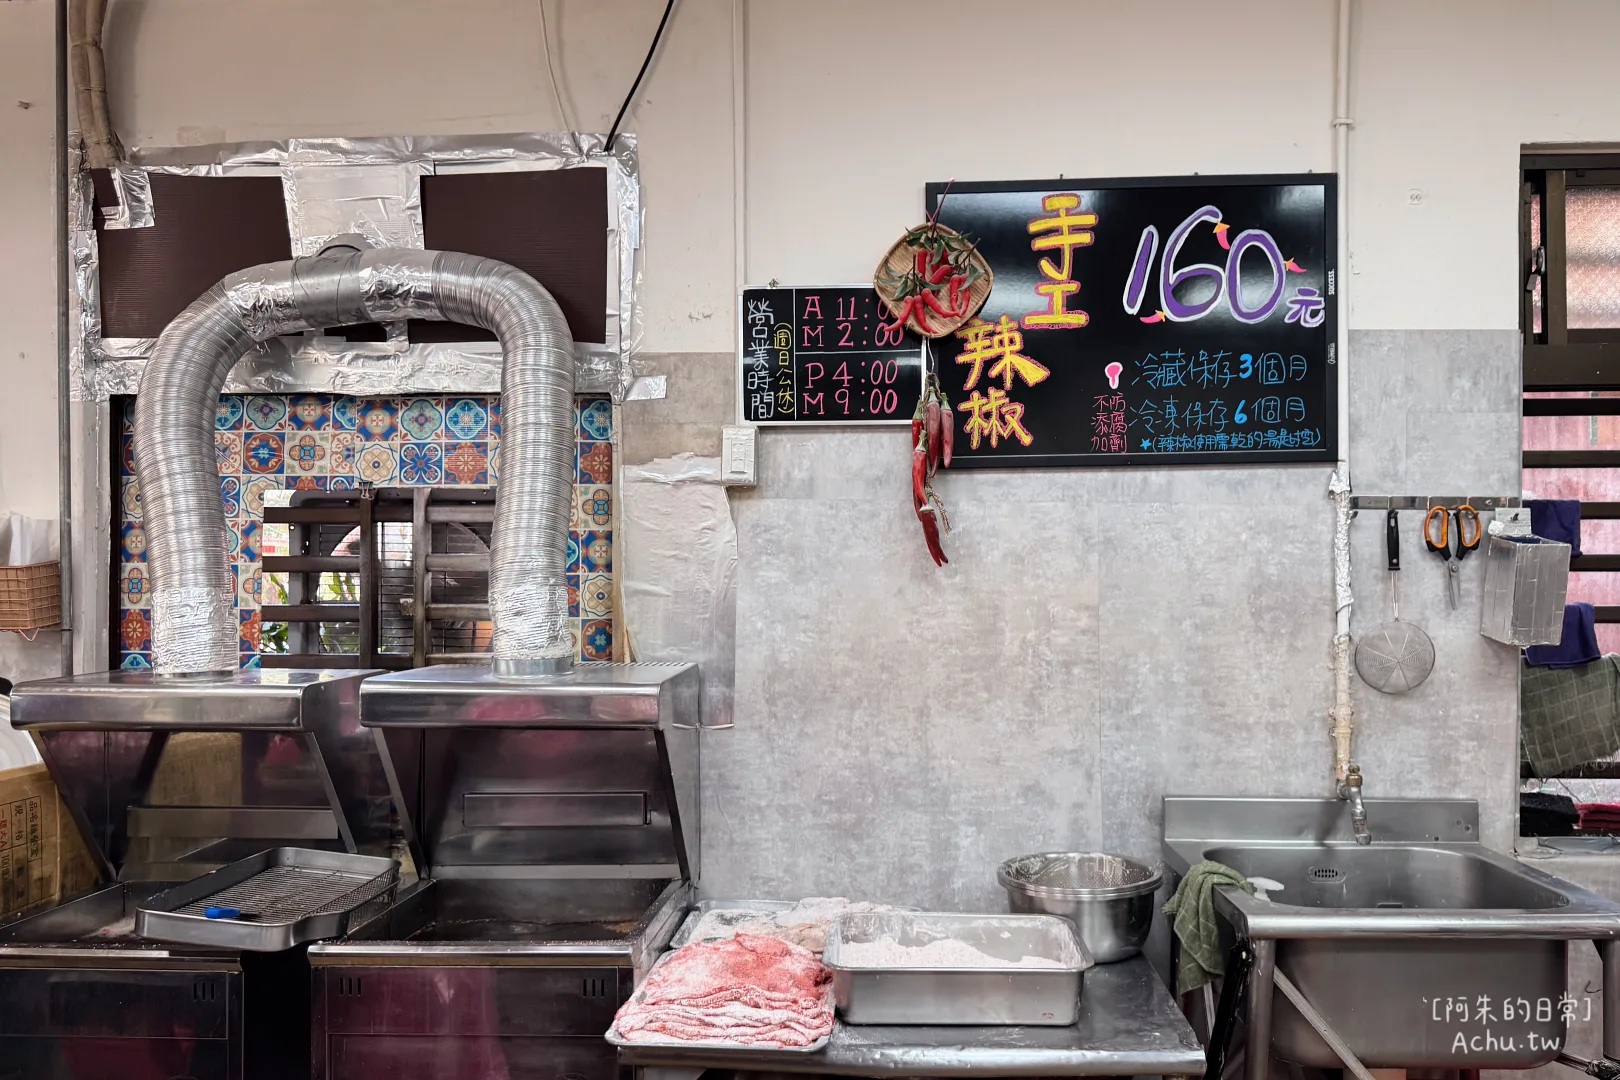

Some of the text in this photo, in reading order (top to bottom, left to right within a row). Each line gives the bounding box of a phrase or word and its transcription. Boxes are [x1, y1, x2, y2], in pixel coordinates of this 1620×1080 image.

[1021, 193, 1098, 329] 手工
[747, 297, 775, 419] 營業時間
[832, 359, 898, 387] 4:00
[834, 388, 898, 415] 9:00
[955, 314, 1050, 450] 辣椒
